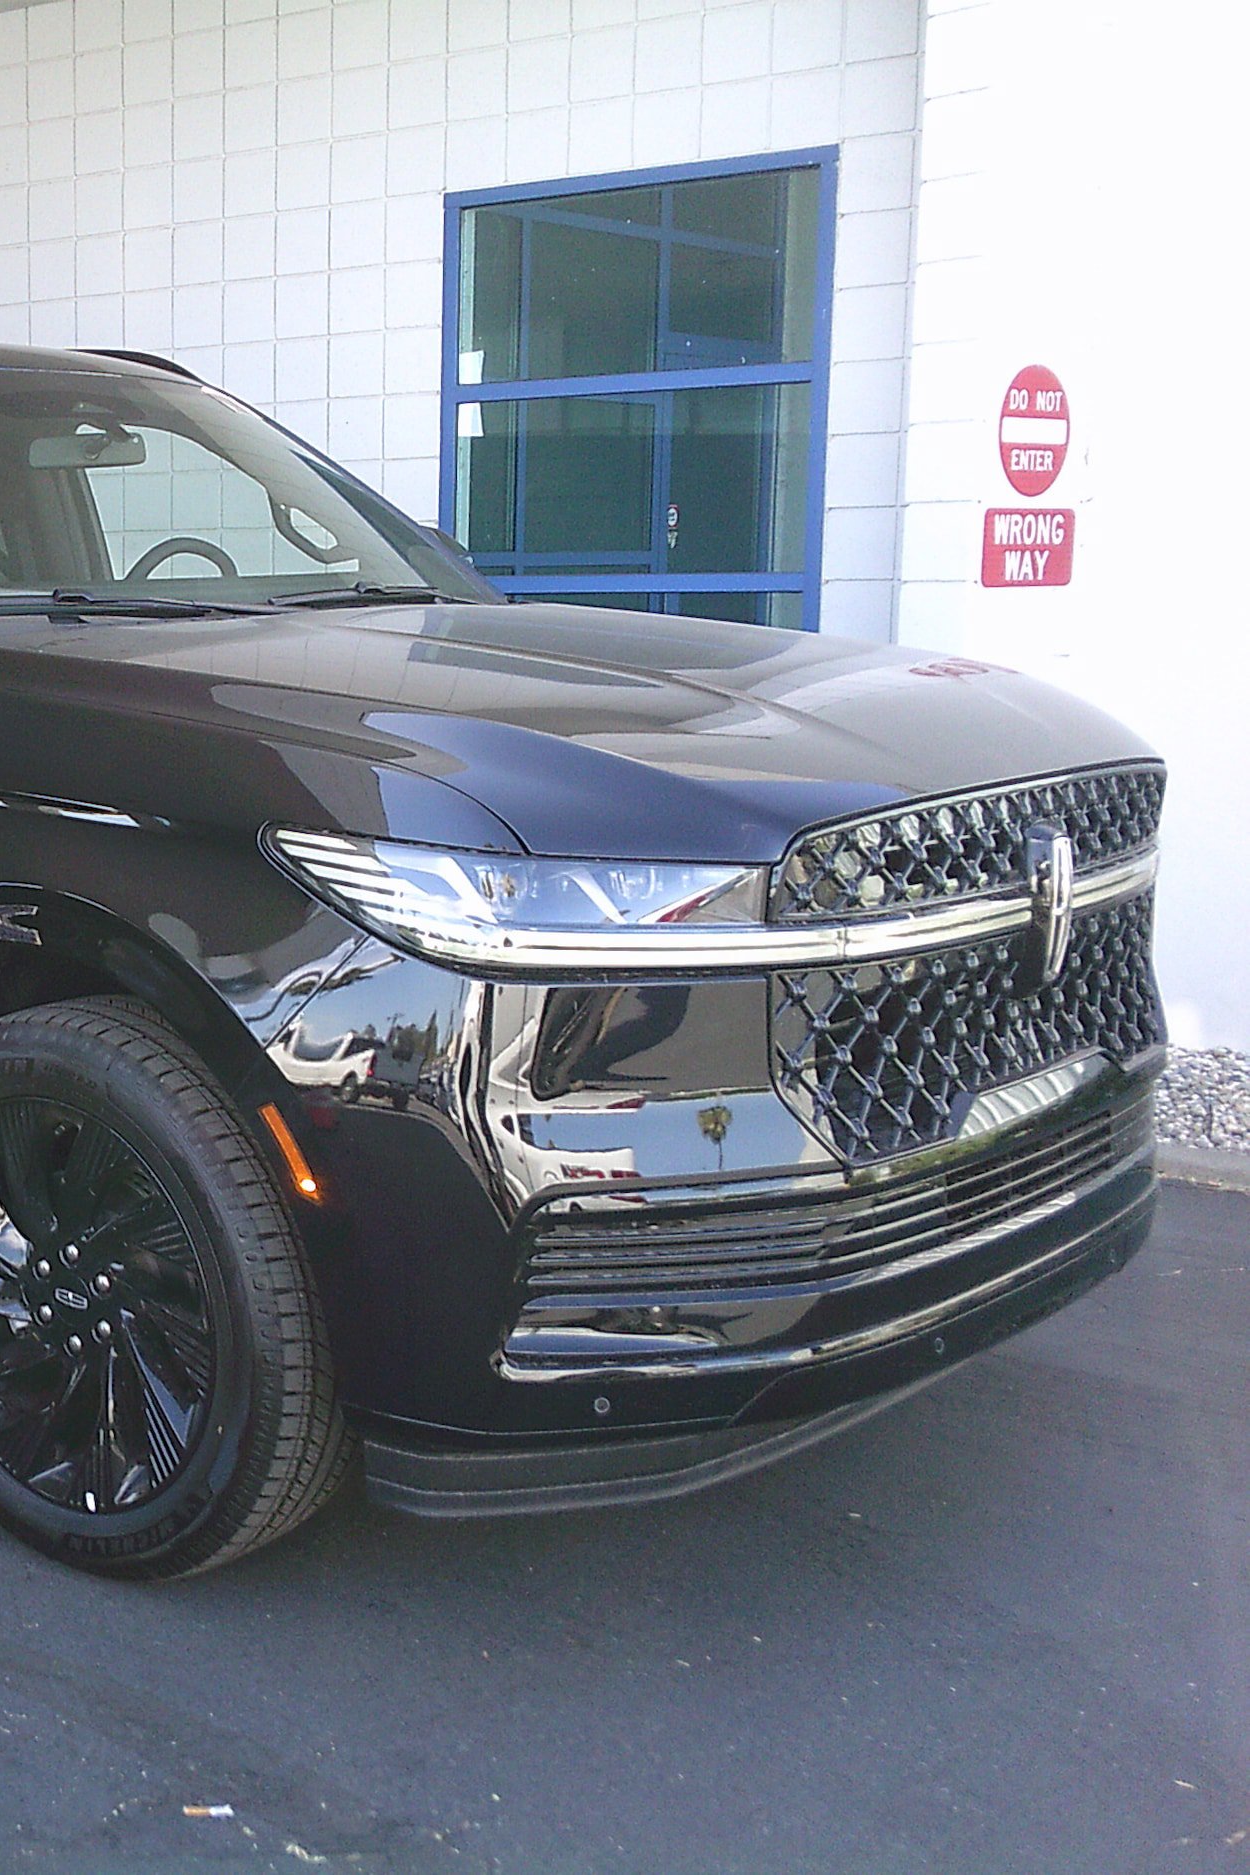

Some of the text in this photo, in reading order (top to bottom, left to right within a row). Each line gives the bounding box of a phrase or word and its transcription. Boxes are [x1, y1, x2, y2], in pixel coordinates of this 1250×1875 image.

[1010, 388, 1063, 412] DO NOT
[1011, 448, 1054, 471] ENTER
[994, 513, 1065, 545] WRONG
[1004, 550, 1050, 581] WAY
